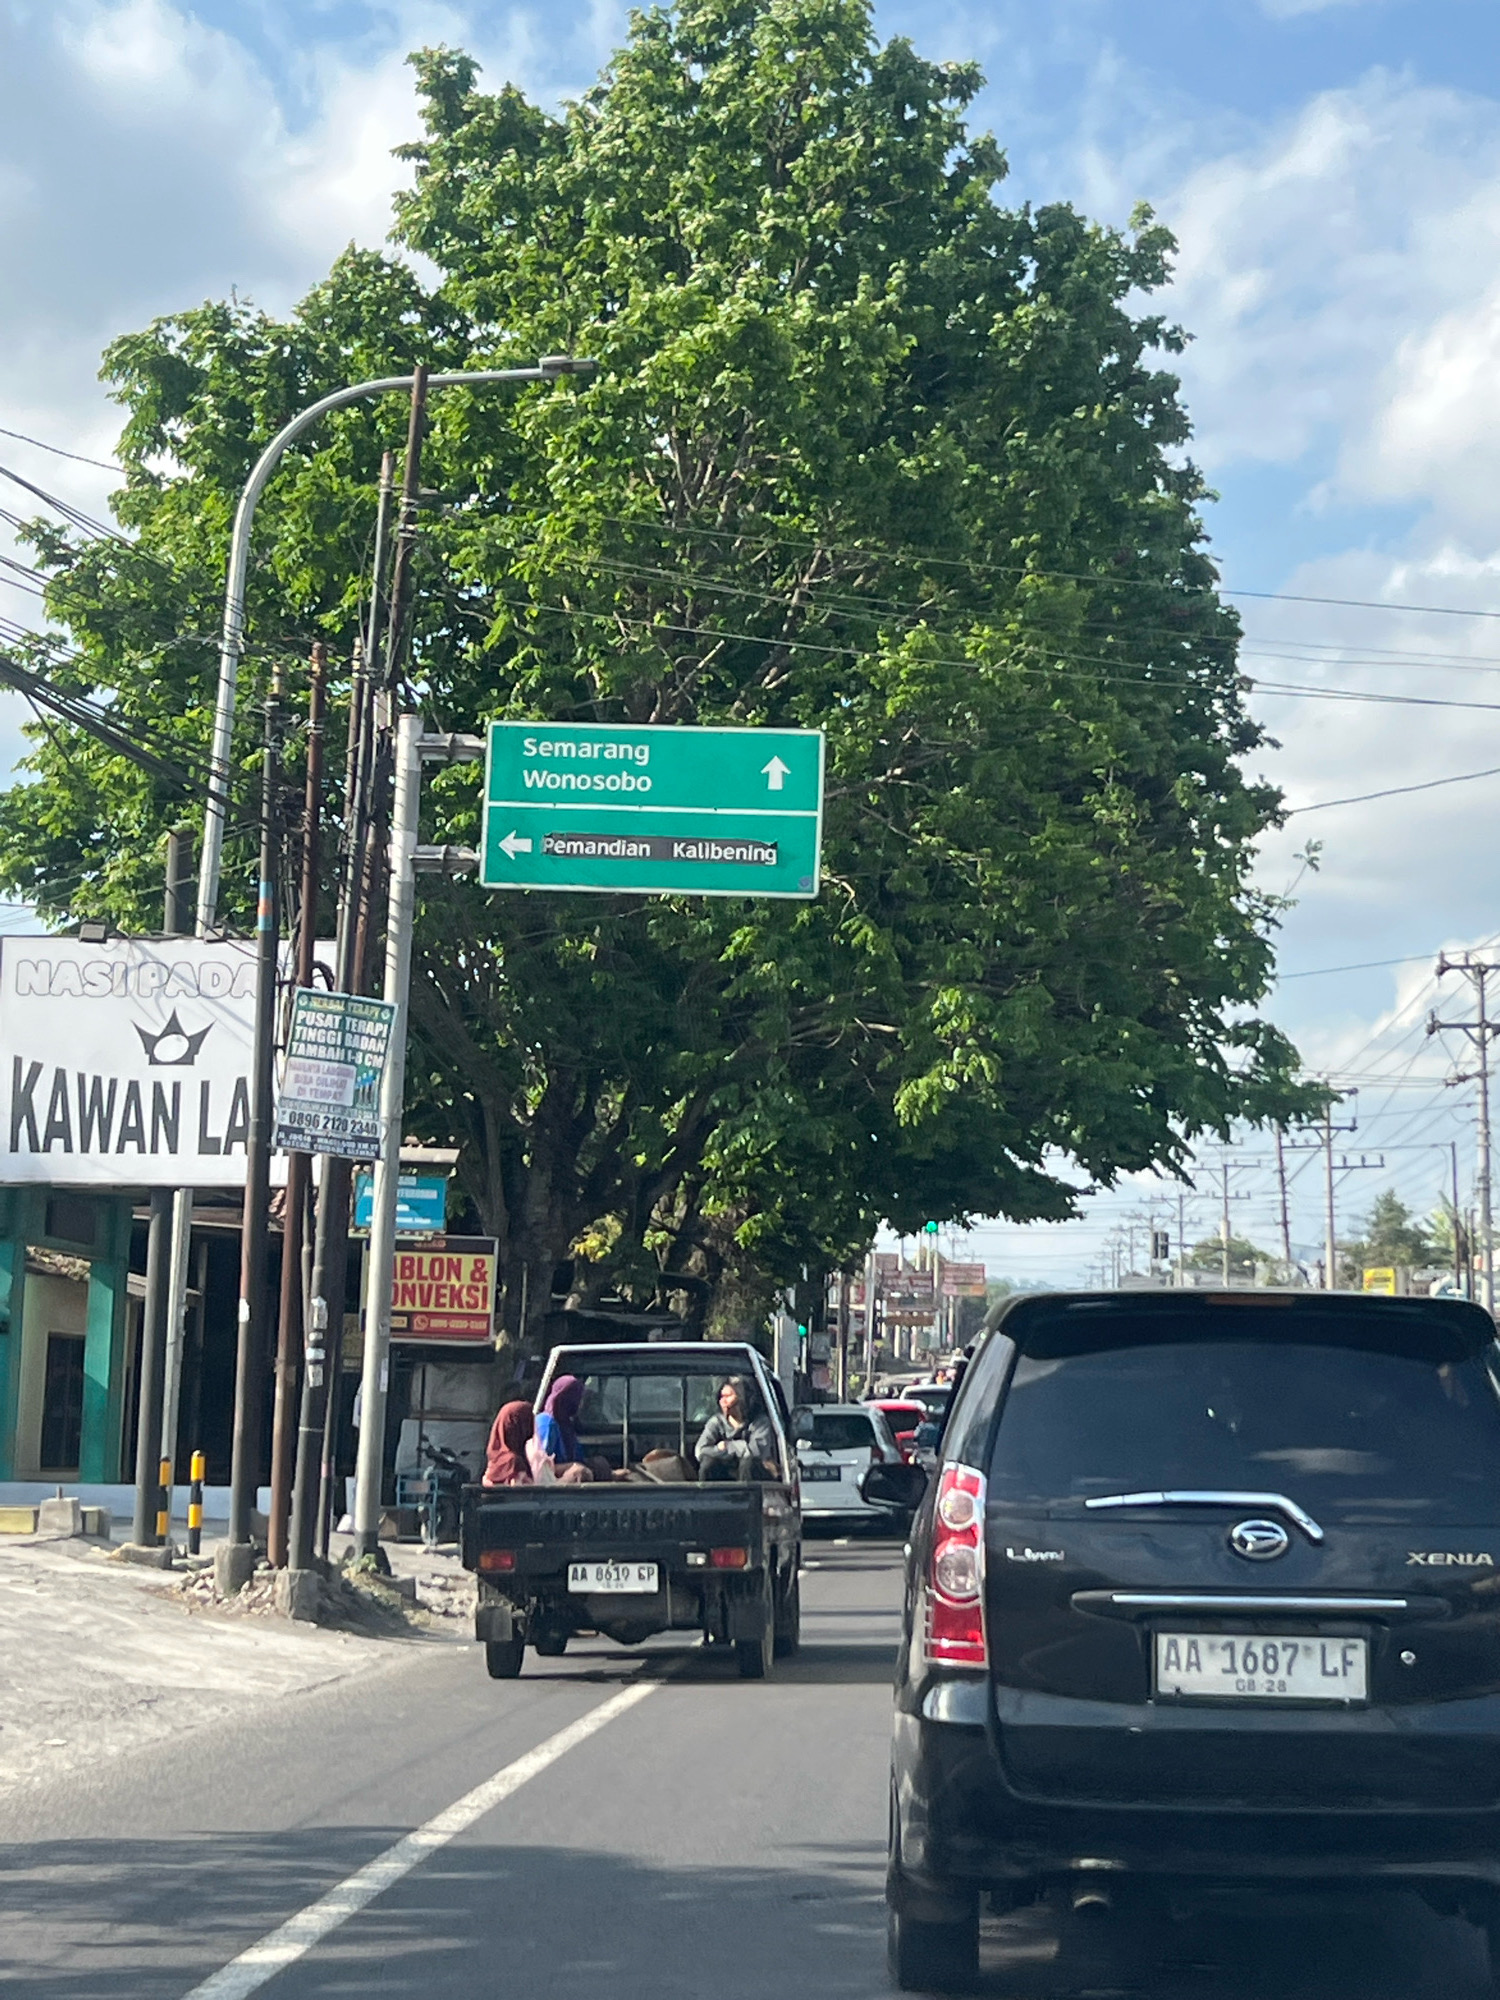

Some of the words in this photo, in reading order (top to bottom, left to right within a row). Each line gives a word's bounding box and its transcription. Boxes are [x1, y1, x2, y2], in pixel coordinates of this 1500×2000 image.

[523, 738, 650, 766] Semarang
[523, 770, 652, 792] Wonosobo
[543, 836, 651, 858] Pemandian
[673, 842, 778, 866] Kalibening
[16, 959, 127, 997] NASI
[138, 961, 258, 998] PADA
[296, 1009, 342, 1029] PUSAT
[344, 1017, 388, 1037] TERAPI
[294, 1026, 341, 1045] TINGGI
[344, 1033, 386, 1052] BADAN
[291, 1042, 344, 1060] TAMBAH
[364, 1053, 383, 1067] CM
[10, 1055, 180, 1154] KAWAN
[197, 1076, 251, 1155] LA
[288, 1111, 320, 1127] 0896
[322, 1116, 348, 1131] 2120
[350, 1120, 377, 1134] 2340
[393, 1256, 462, 1282] BLON
[470, 1258, 488, 1283] &
[1406, 1550, 1493, 1567] XENIA
[571, 1566, 588, 1581] AA
[1164, 1638, 1202, 1672] AA
[1221, 1640, 1300, 1676] 1687
[1320, 1643, 1358, 1677] LF
[1265, 1678, 1287, 1692] 28
